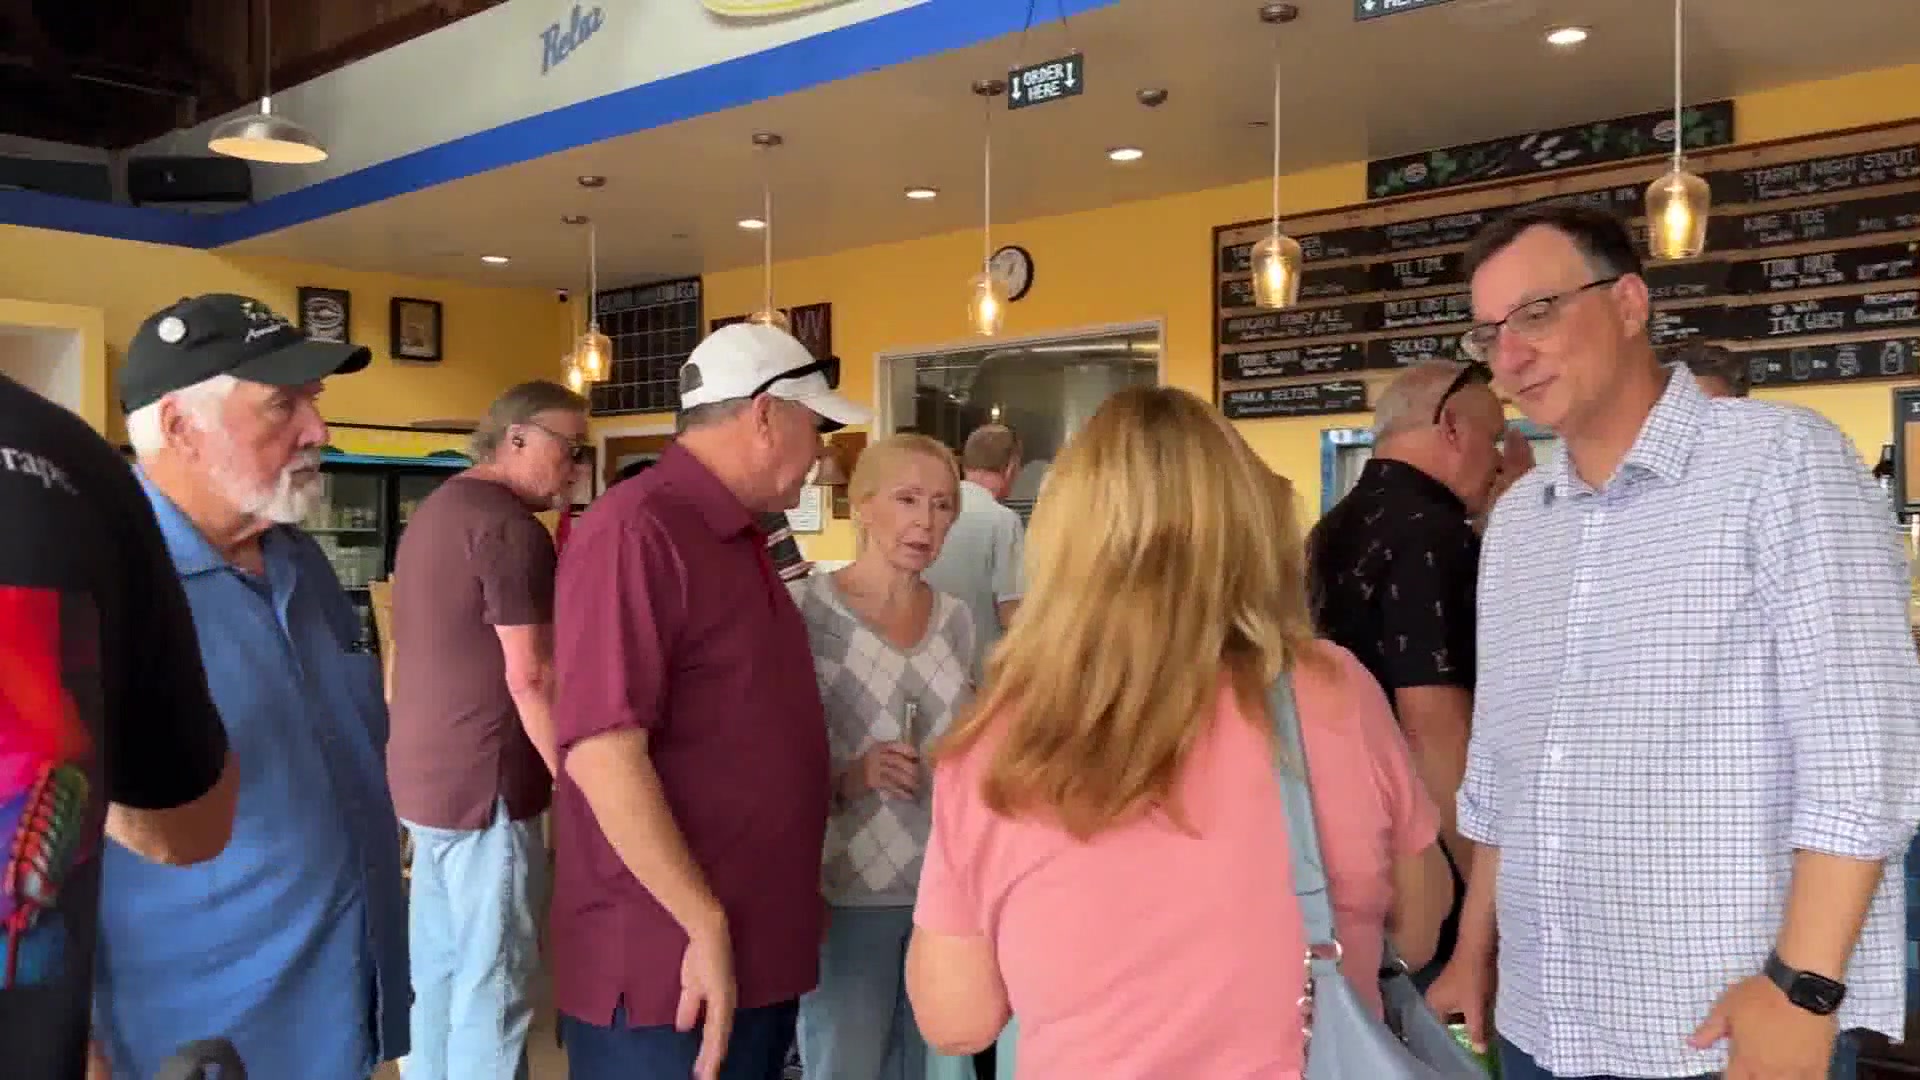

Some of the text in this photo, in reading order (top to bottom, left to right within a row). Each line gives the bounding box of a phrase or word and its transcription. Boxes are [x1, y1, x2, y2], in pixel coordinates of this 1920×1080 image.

[1024, 63, 1064, 86] ORDER
[1027, 80, 1062, 102] HERE
[1863, 148, 1918, 170] STOUT
